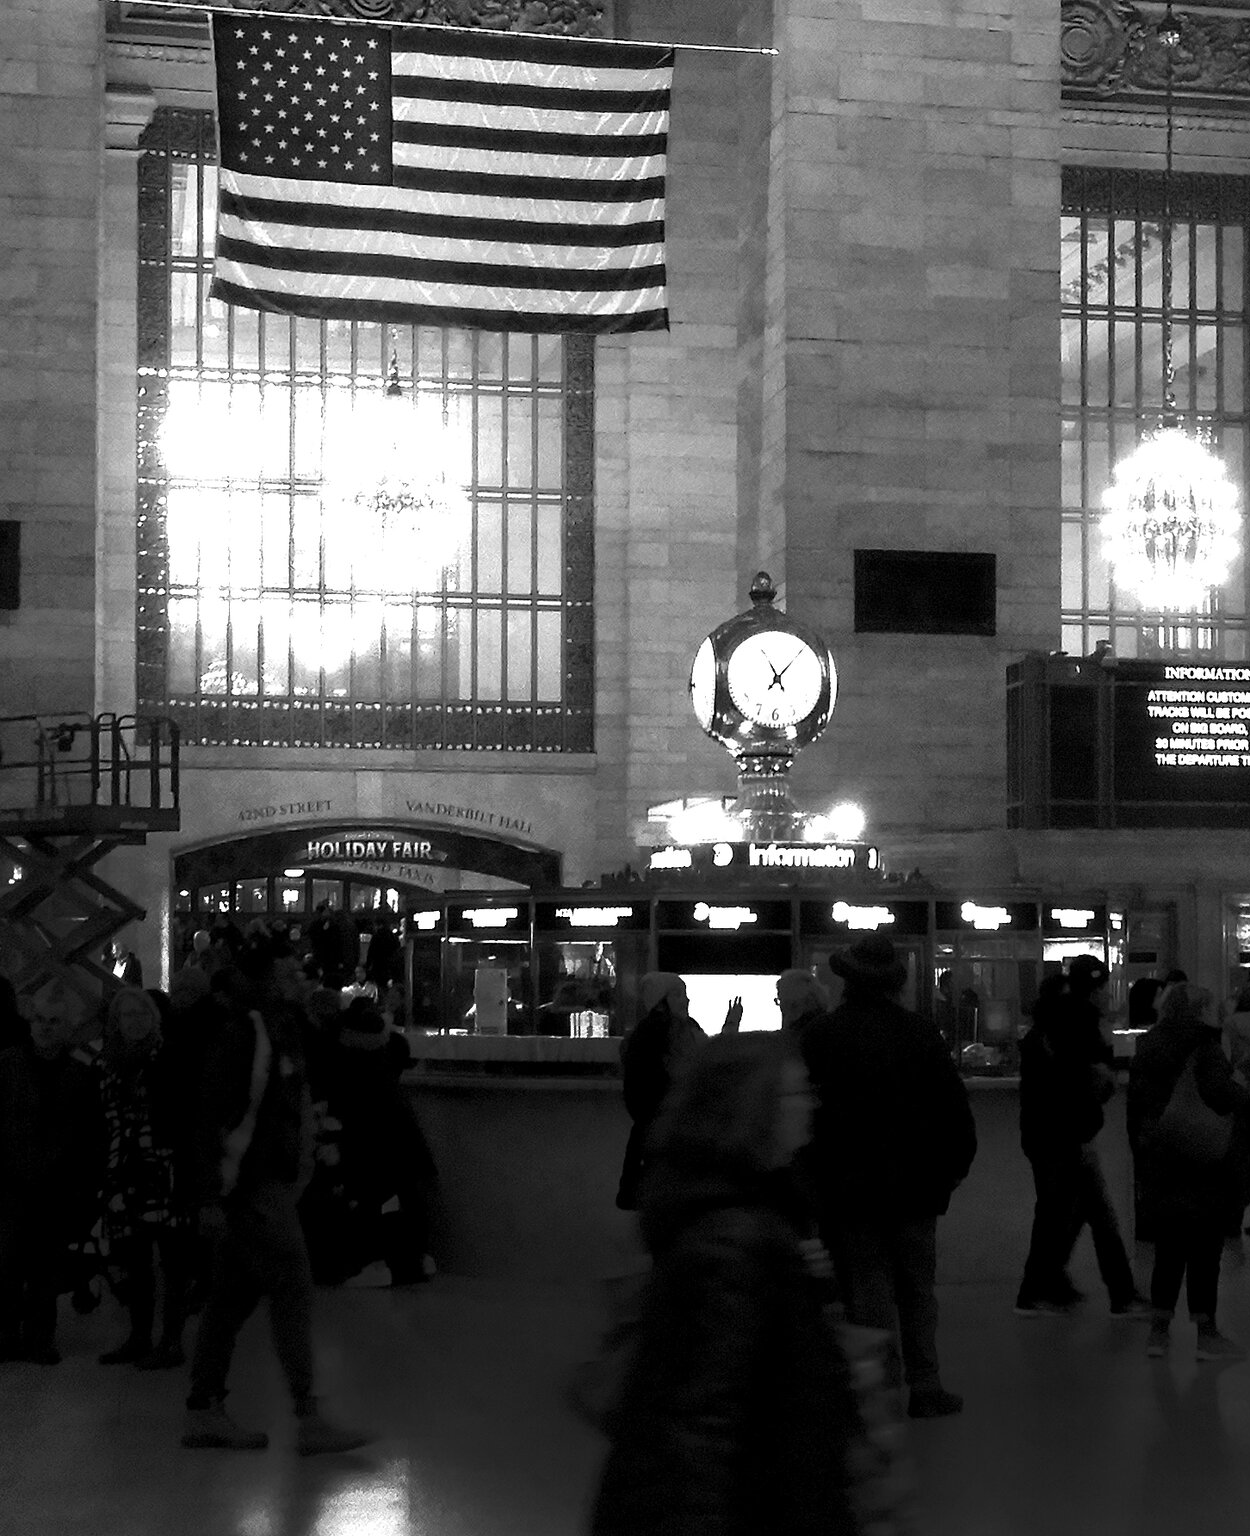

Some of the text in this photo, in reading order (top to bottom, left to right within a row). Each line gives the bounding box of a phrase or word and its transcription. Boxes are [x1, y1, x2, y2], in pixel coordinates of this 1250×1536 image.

[1148, 691, 1204, 702] ATTENTION
[772, 708, 779, 721] 6
[1148, 706, 1189, 717] TRACKS
[1191, 707, 1214, 718] WILL
[1216, 708, 1230, 718] BE
[1173, 723, 1188, 733] ON
[1170, 739, 1215, 749] MINUTES
[1217, 739, 1248, 750] PRIOR
[1155, 754, 1176, 764] THE
[1178, 755, 1239, 765] DEPARTURE
[280, 799, 333, 815] STREET
[406, 800, 533, 834] VANDERBILT HALL
[307, 840, 432, 860] HOLIDAY FAIR
[749, 843, 855, 867] Information
